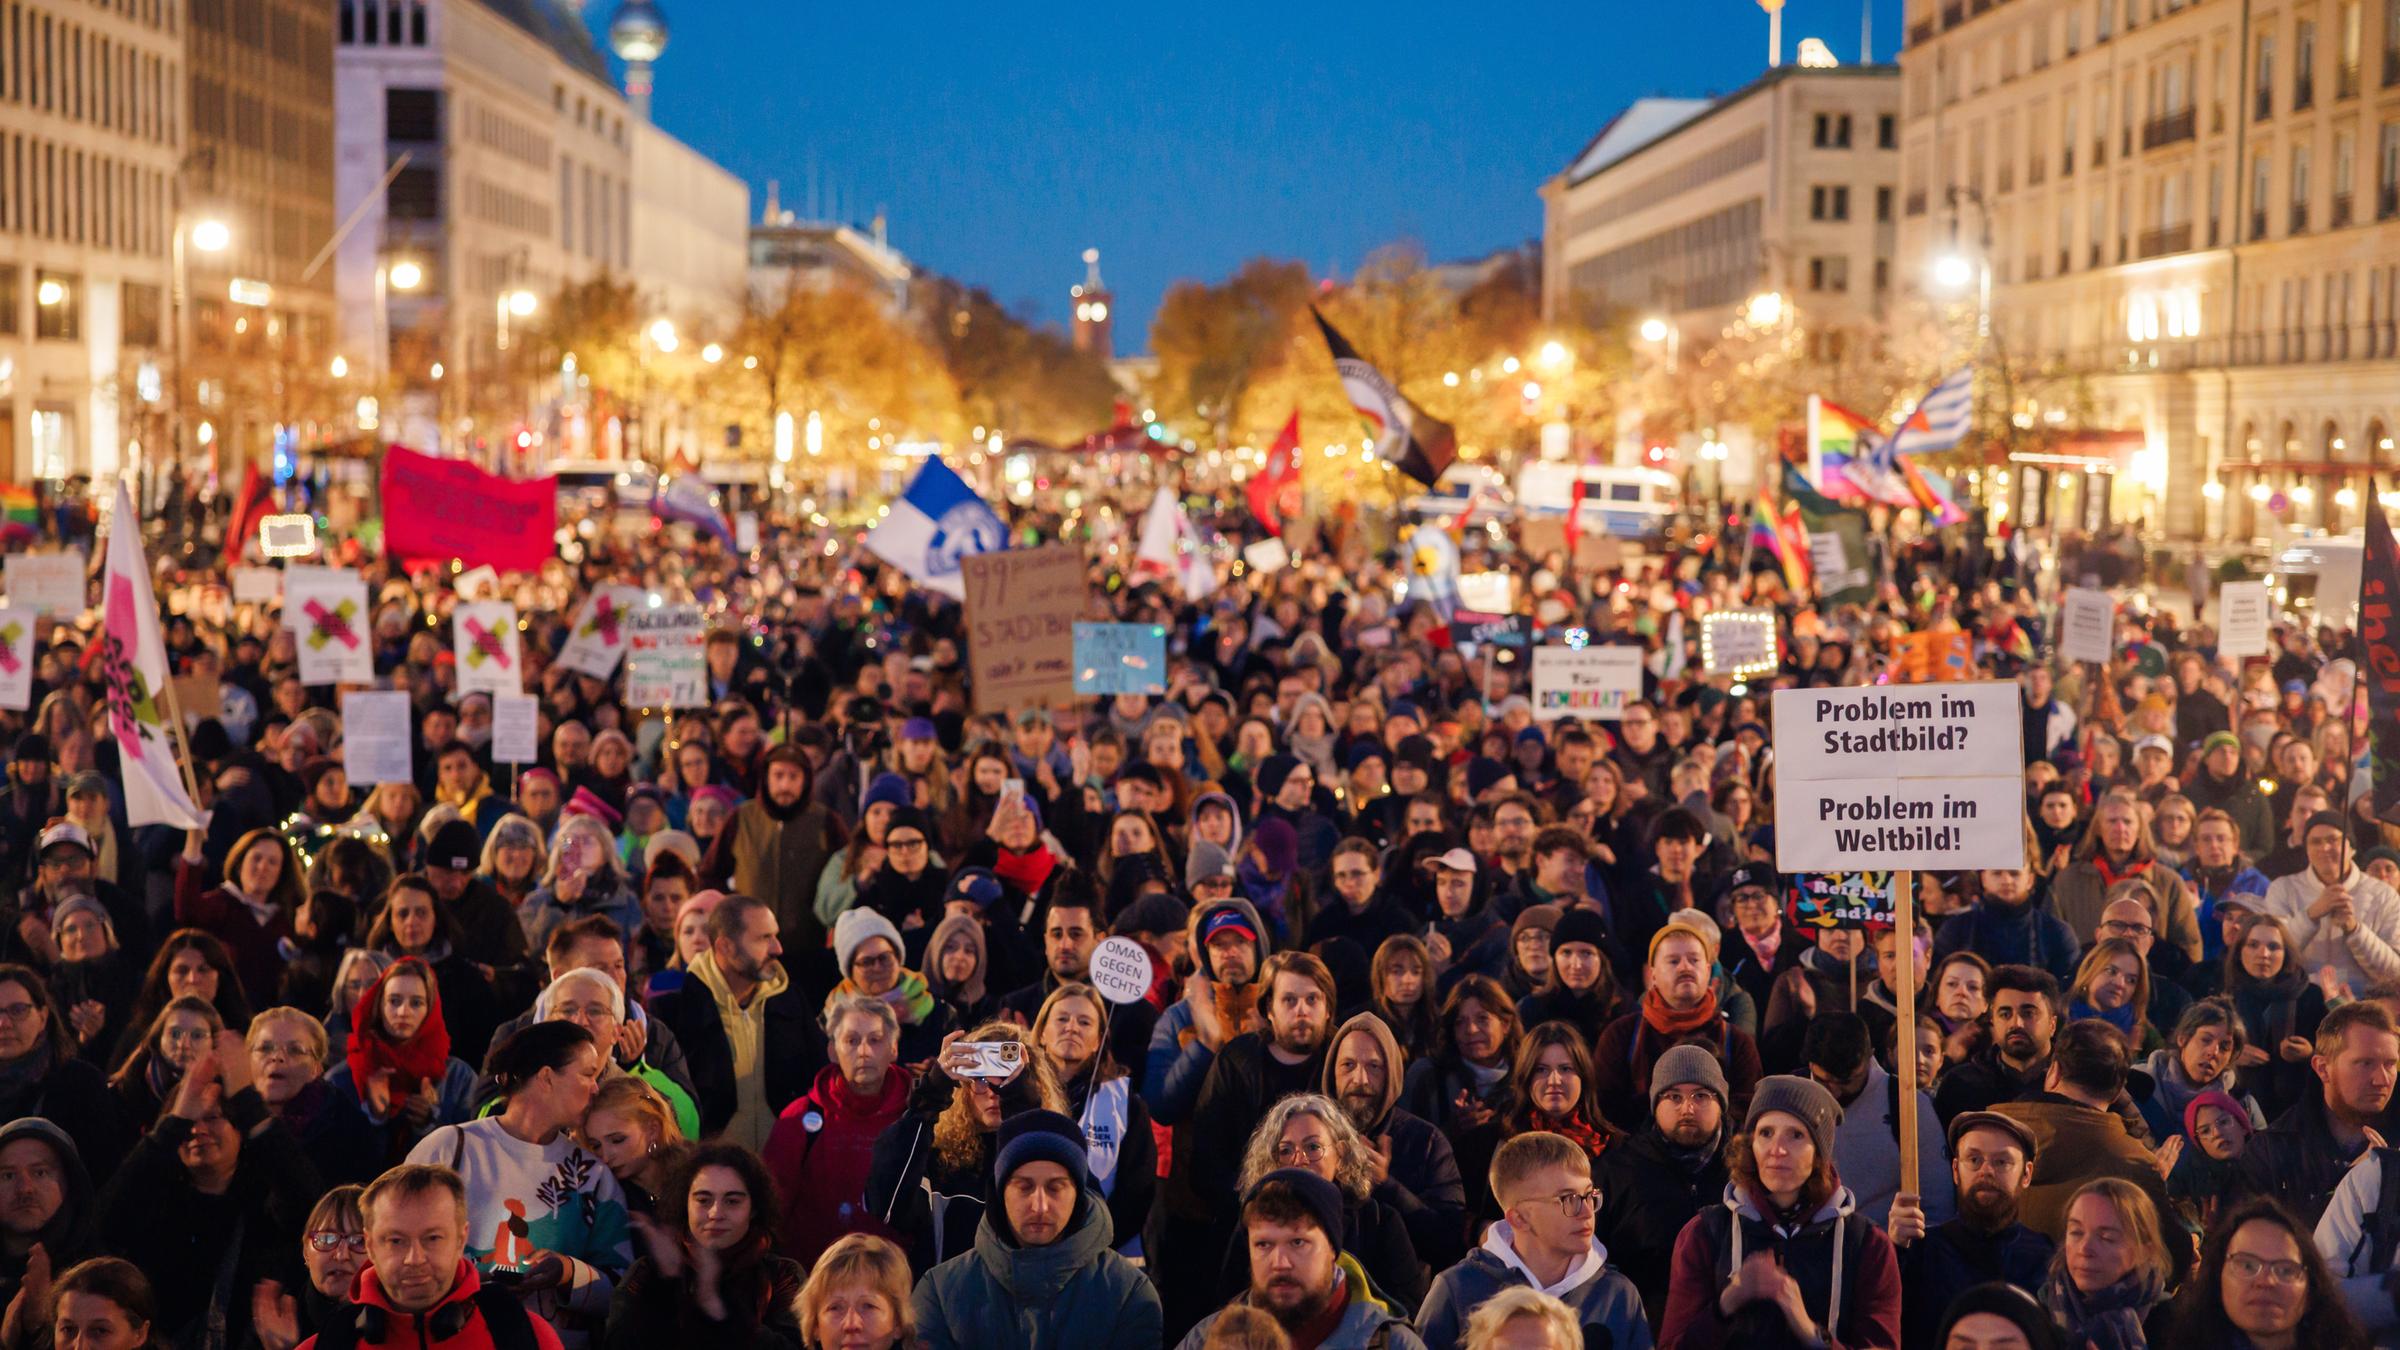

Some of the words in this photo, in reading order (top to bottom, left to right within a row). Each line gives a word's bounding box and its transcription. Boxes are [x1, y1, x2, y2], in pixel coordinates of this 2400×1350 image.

[1816, 696, 1932, 722] Problem
[1941, 693, 1976, 718] im
[1824, 726, 1968, 754] Stadtbild?
[1819, 795, 1934, 821] Problem
[1943, 794, 1977, 819] im
[1834, 826, 1961, 852] Weltbild!
[1813, 880, 1888, 899] Reichs
[1835, 907, 1896, 922] adler
[1105, 940, 1144, 963] OMAS
[1099, 955, 1142, 980] GEGEN
[1094, 970, 1142, 997] RECHTS
